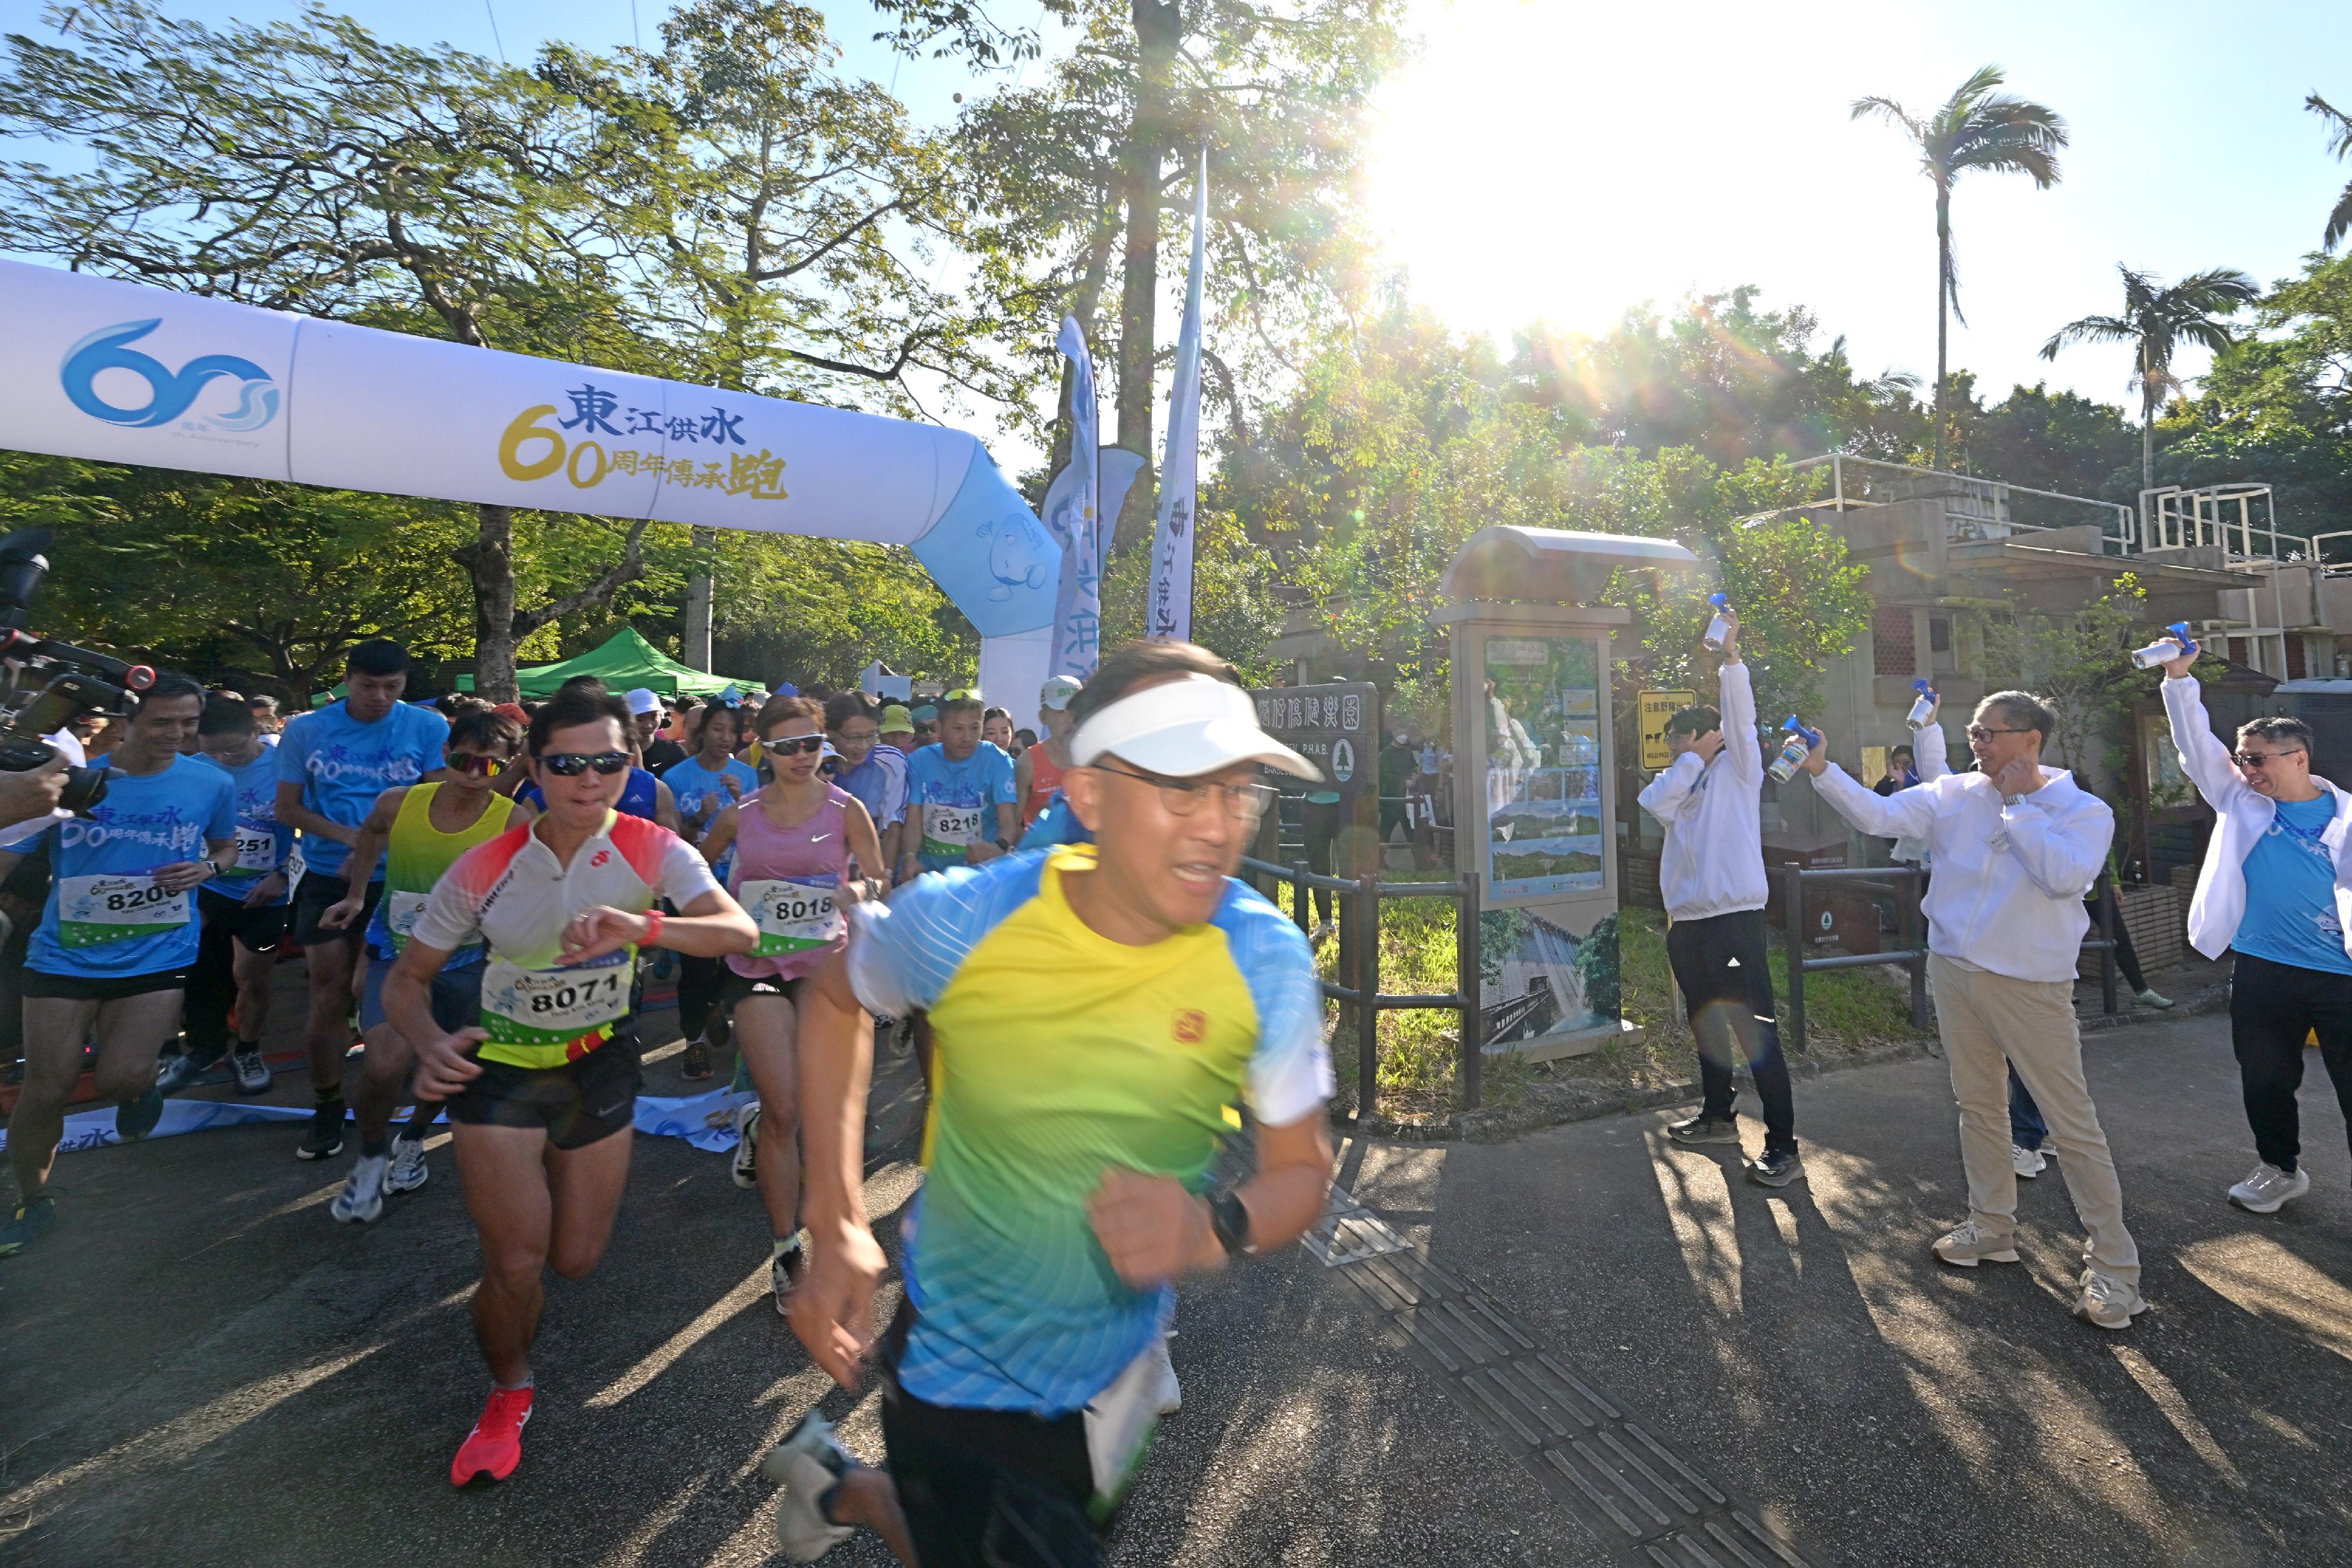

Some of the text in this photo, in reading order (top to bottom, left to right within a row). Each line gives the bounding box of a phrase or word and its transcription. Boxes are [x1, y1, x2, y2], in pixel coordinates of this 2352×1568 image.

[559, 383, 746, 446] 東江供水
[1303, 743, 1329, 755] P.H.A.B.
[940, 814, 978, 832] 8218
[776, 897, 833, 920] 8018
[532, 973, 618, 1013] 8071
